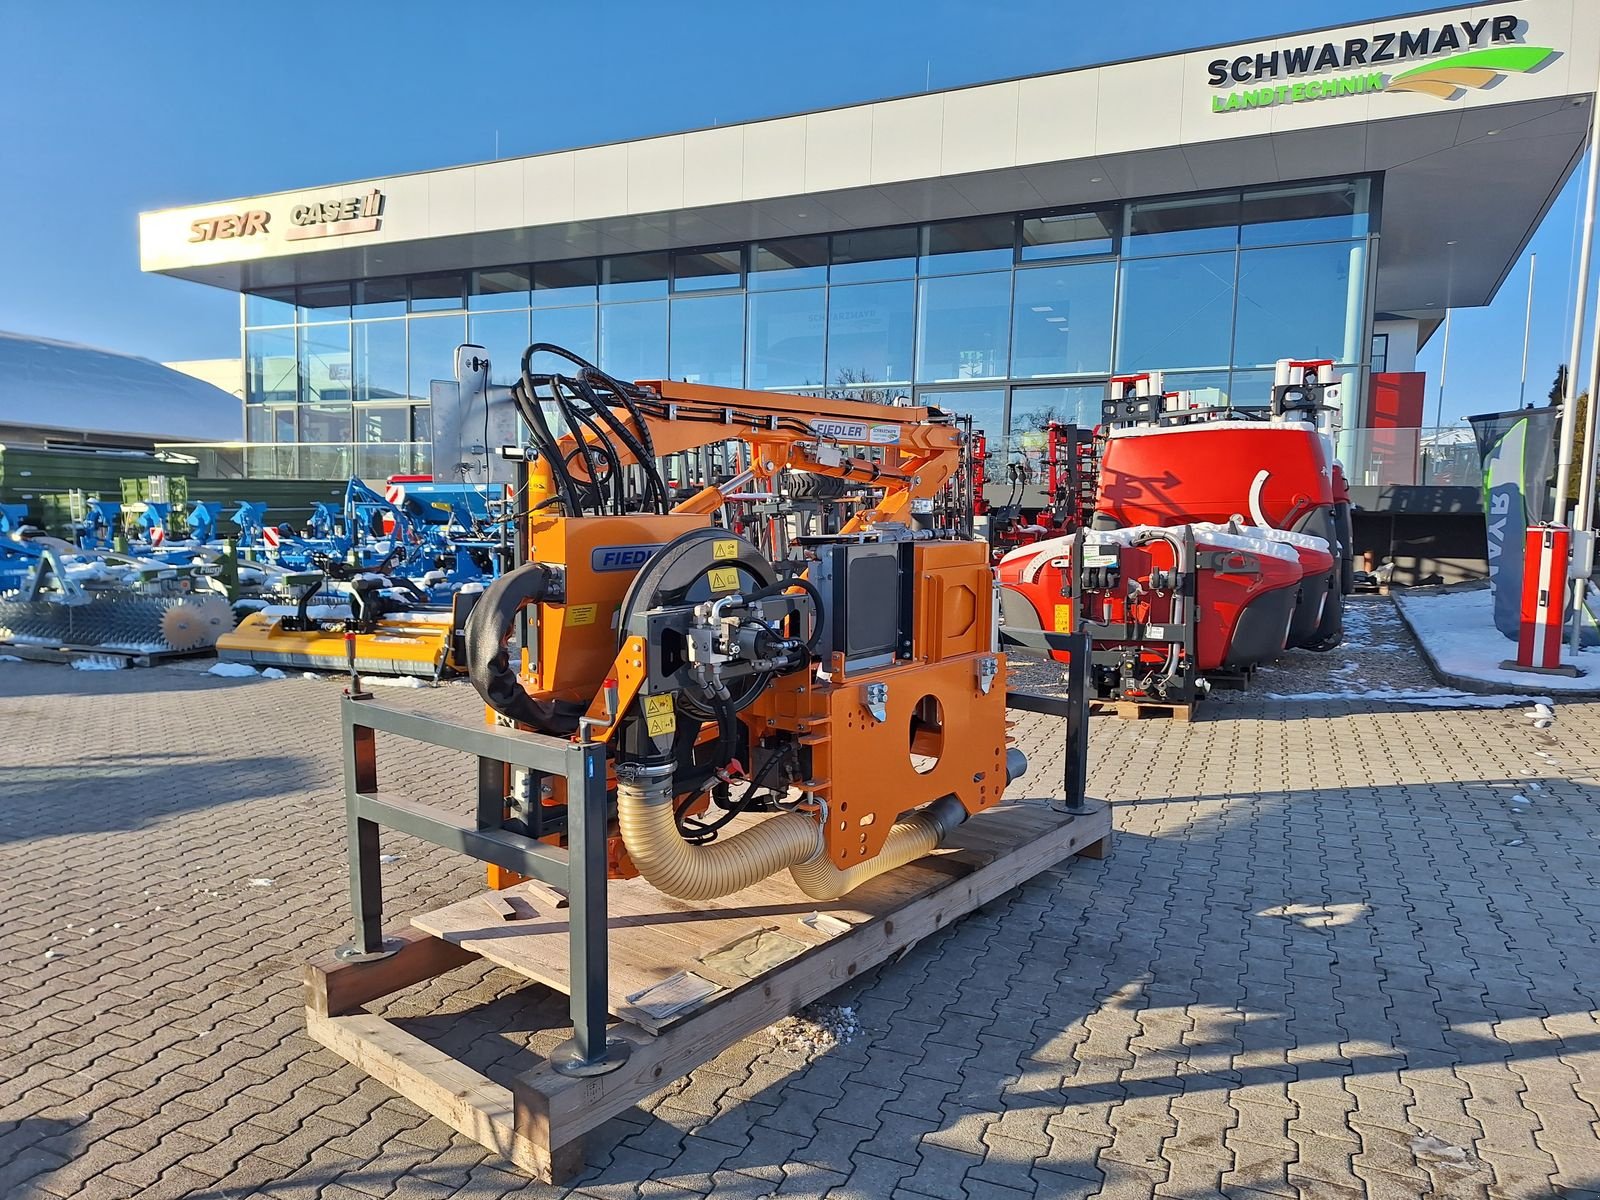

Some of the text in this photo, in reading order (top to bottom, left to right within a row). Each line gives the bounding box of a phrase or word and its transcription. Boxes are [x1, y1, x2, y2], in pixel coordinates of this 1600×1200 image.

[1207, 14, 1518, 86] SCHWARZMAYR
[1211, 72, 1385, 113] LANDTECHNIK
[187, 209, 270, 242] STEYR
[290, 197, 358, 226] CASE
[816, 424, 862, 437] FIEDLER
